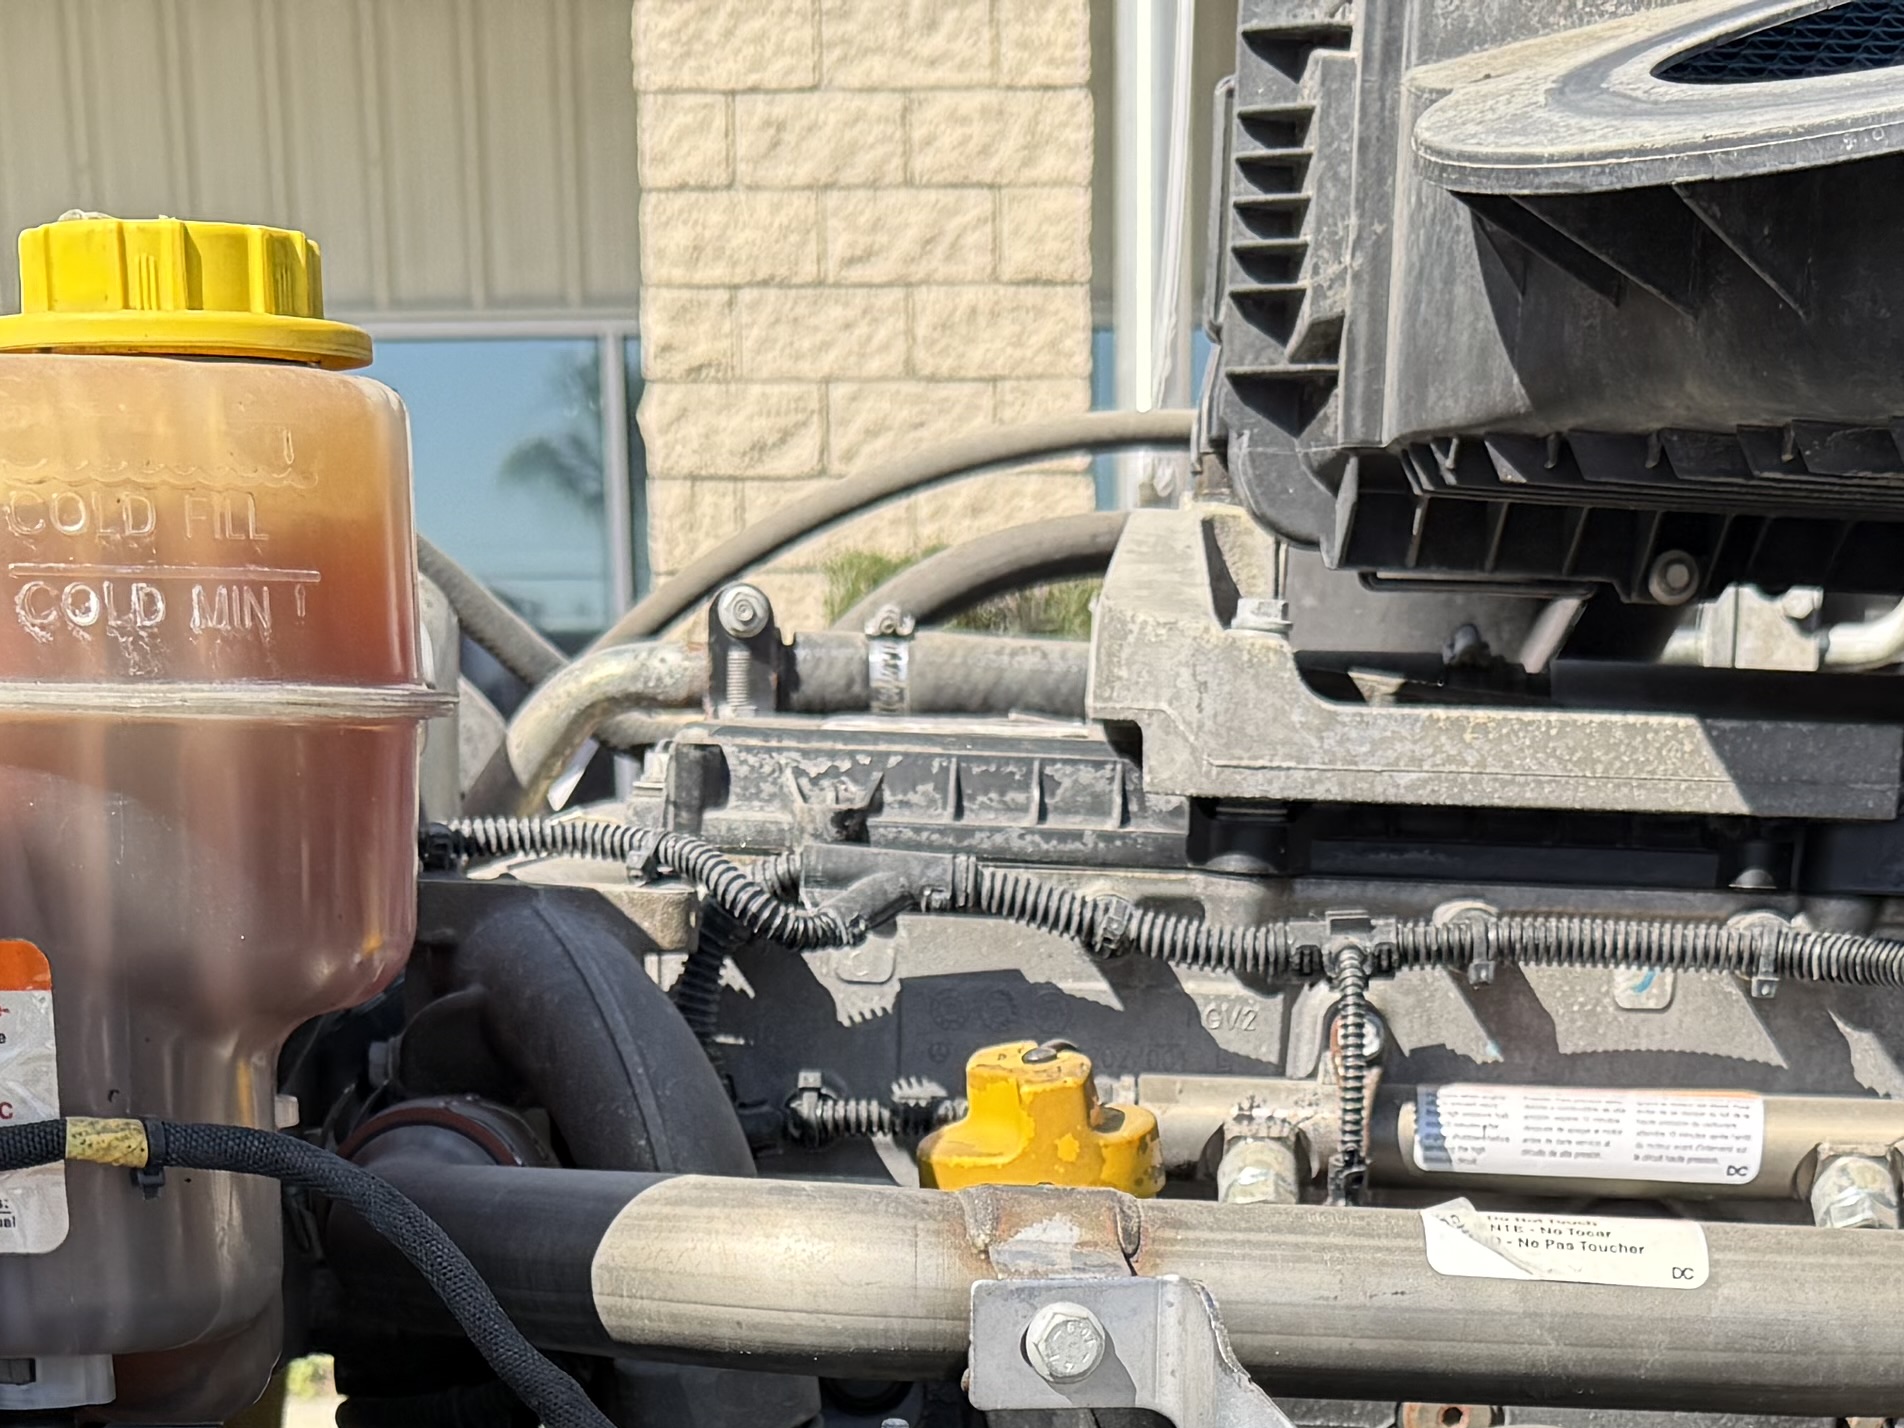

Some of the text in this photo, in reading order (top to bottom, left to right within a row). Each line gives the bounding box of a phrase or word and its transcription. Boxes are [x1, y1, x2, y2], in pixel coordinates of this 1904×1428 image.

[3, 490, 270, 541] COLD FILL
[15, 580, 273, 634] COLD MIN
[1726, 1165, 1749, 1177] DC
[1545, 1238, 1574, 1251] Pas
[1672, 1267, 1695, 1281] DC
